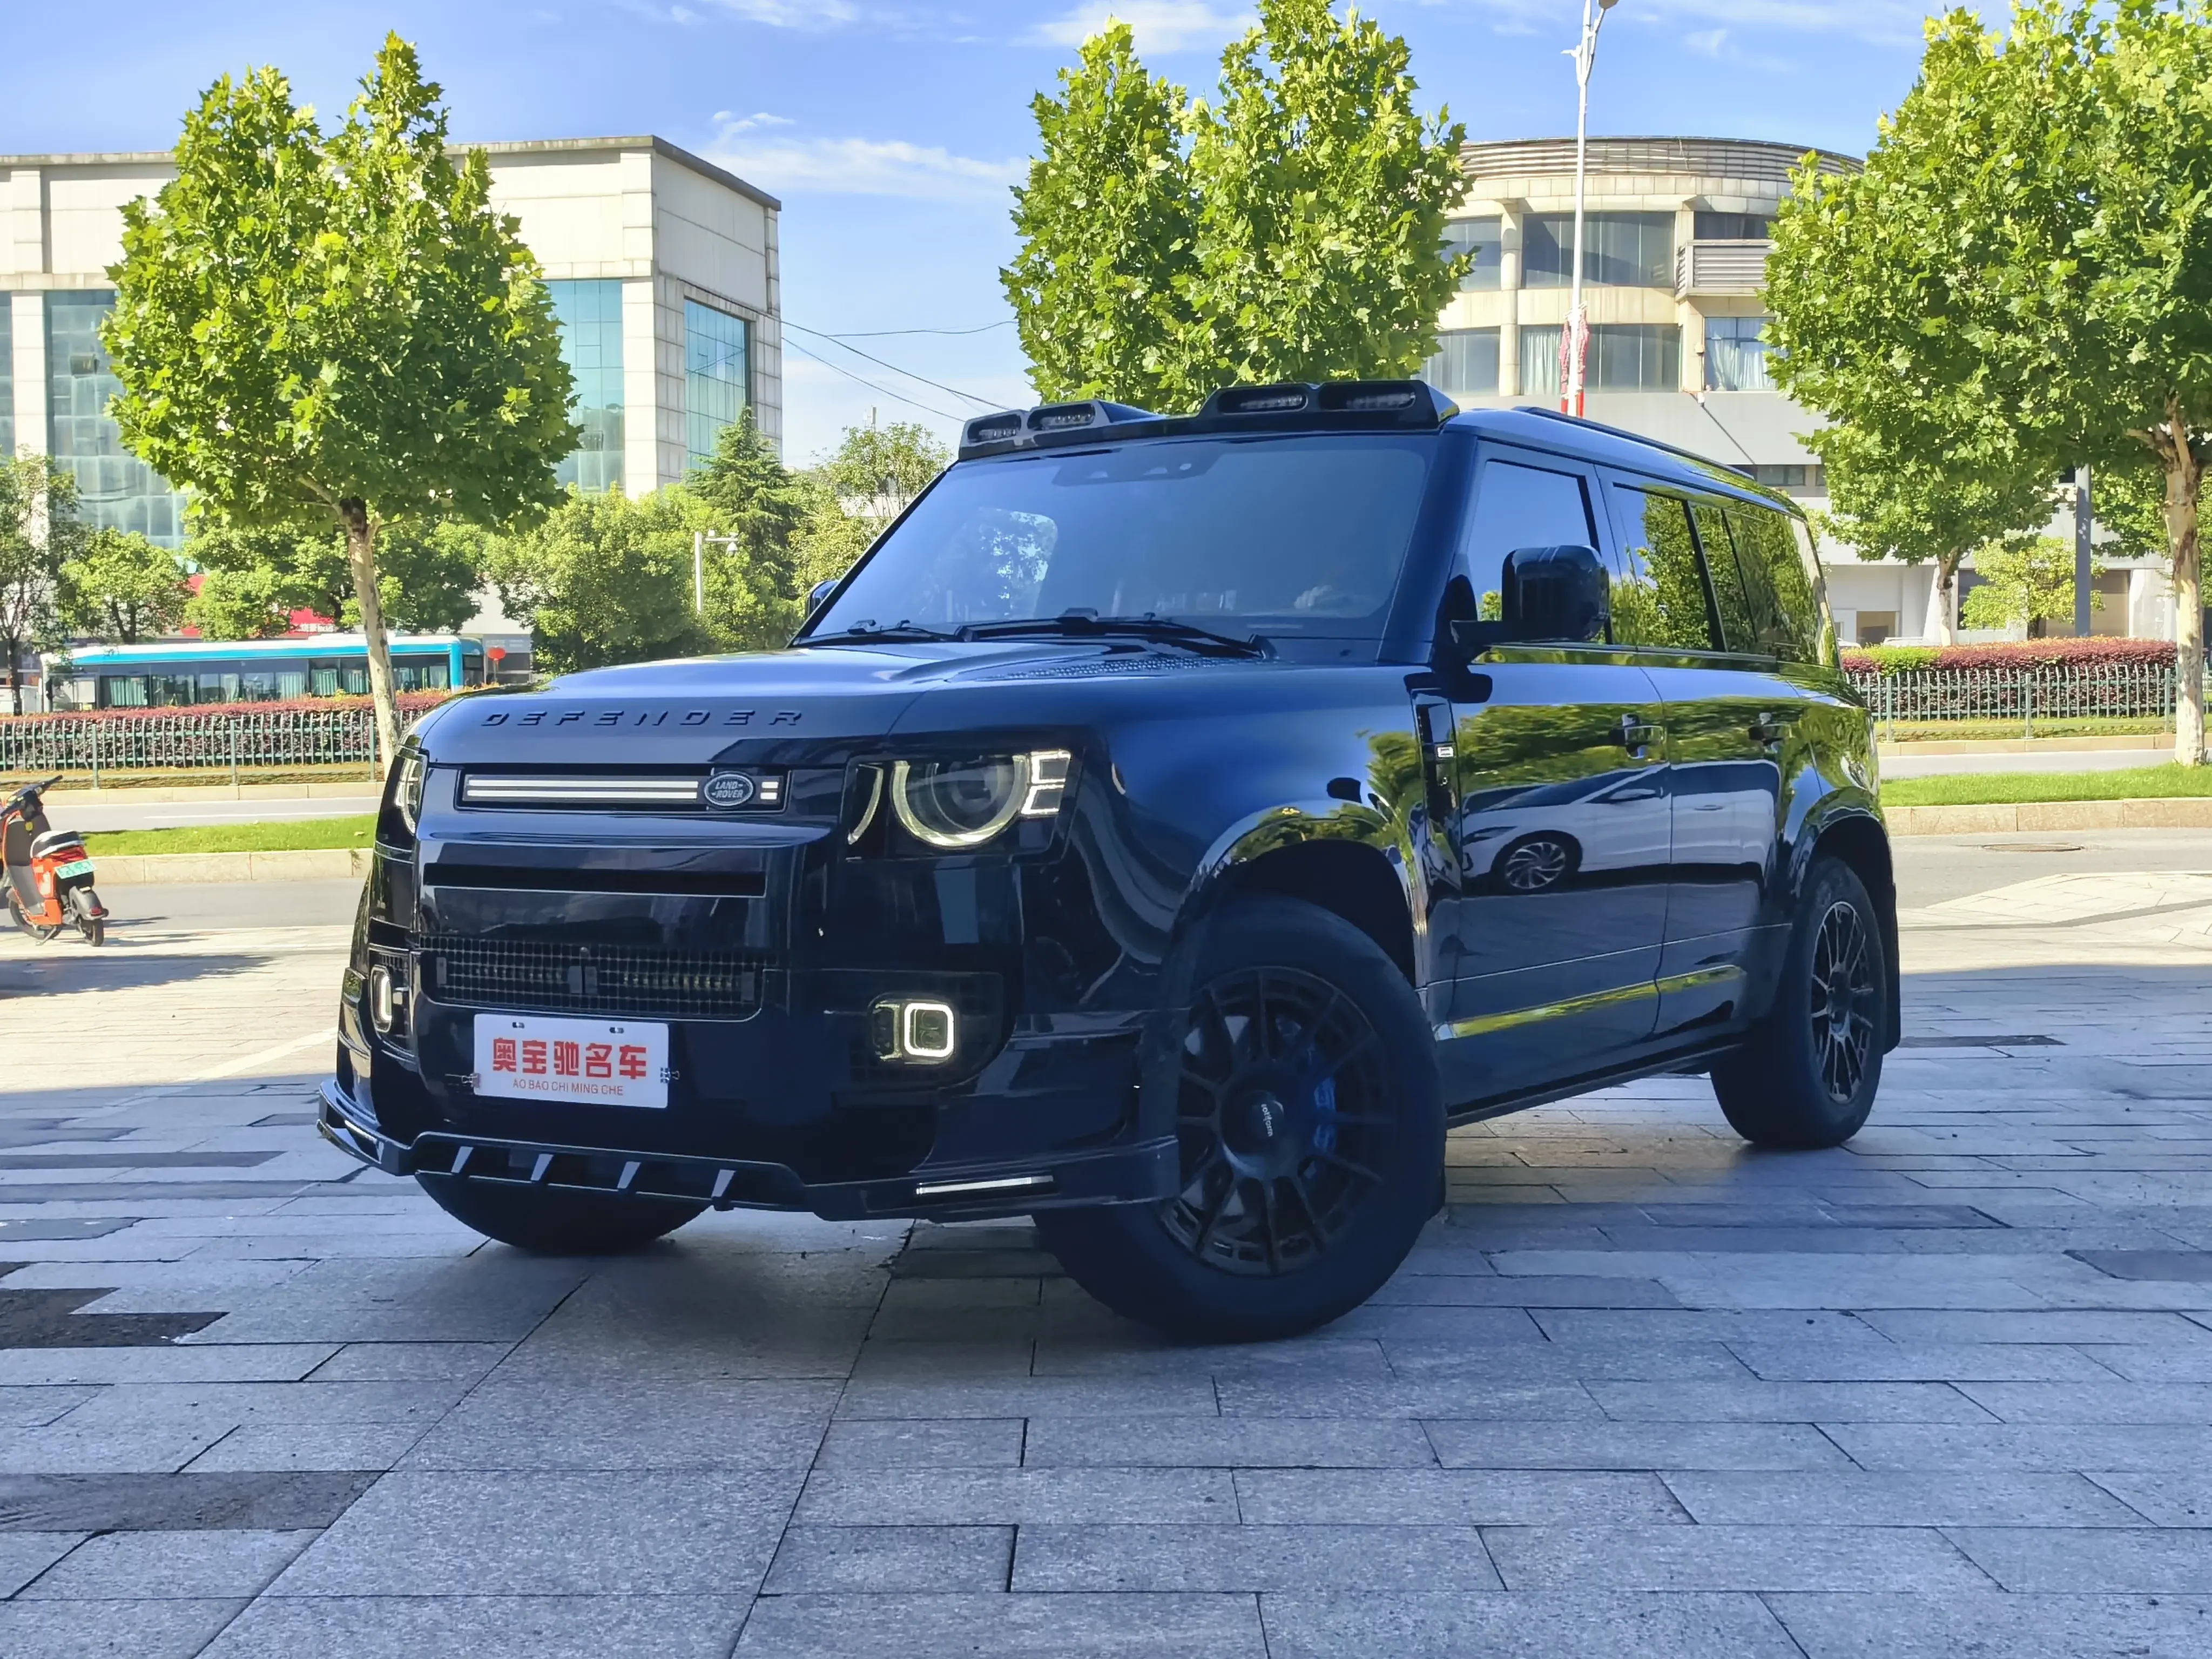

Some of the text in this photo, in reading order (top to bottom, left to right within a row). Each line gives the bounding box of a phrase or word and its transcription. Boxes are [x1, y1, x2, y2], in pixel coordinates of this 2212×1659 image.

[482, 710, 802, 727] DEFENDER
[493, 1037, 647, 1079] 奥宝驰名车
[513, 1078, 624, 1096] AO BAO CHI MING CHE
